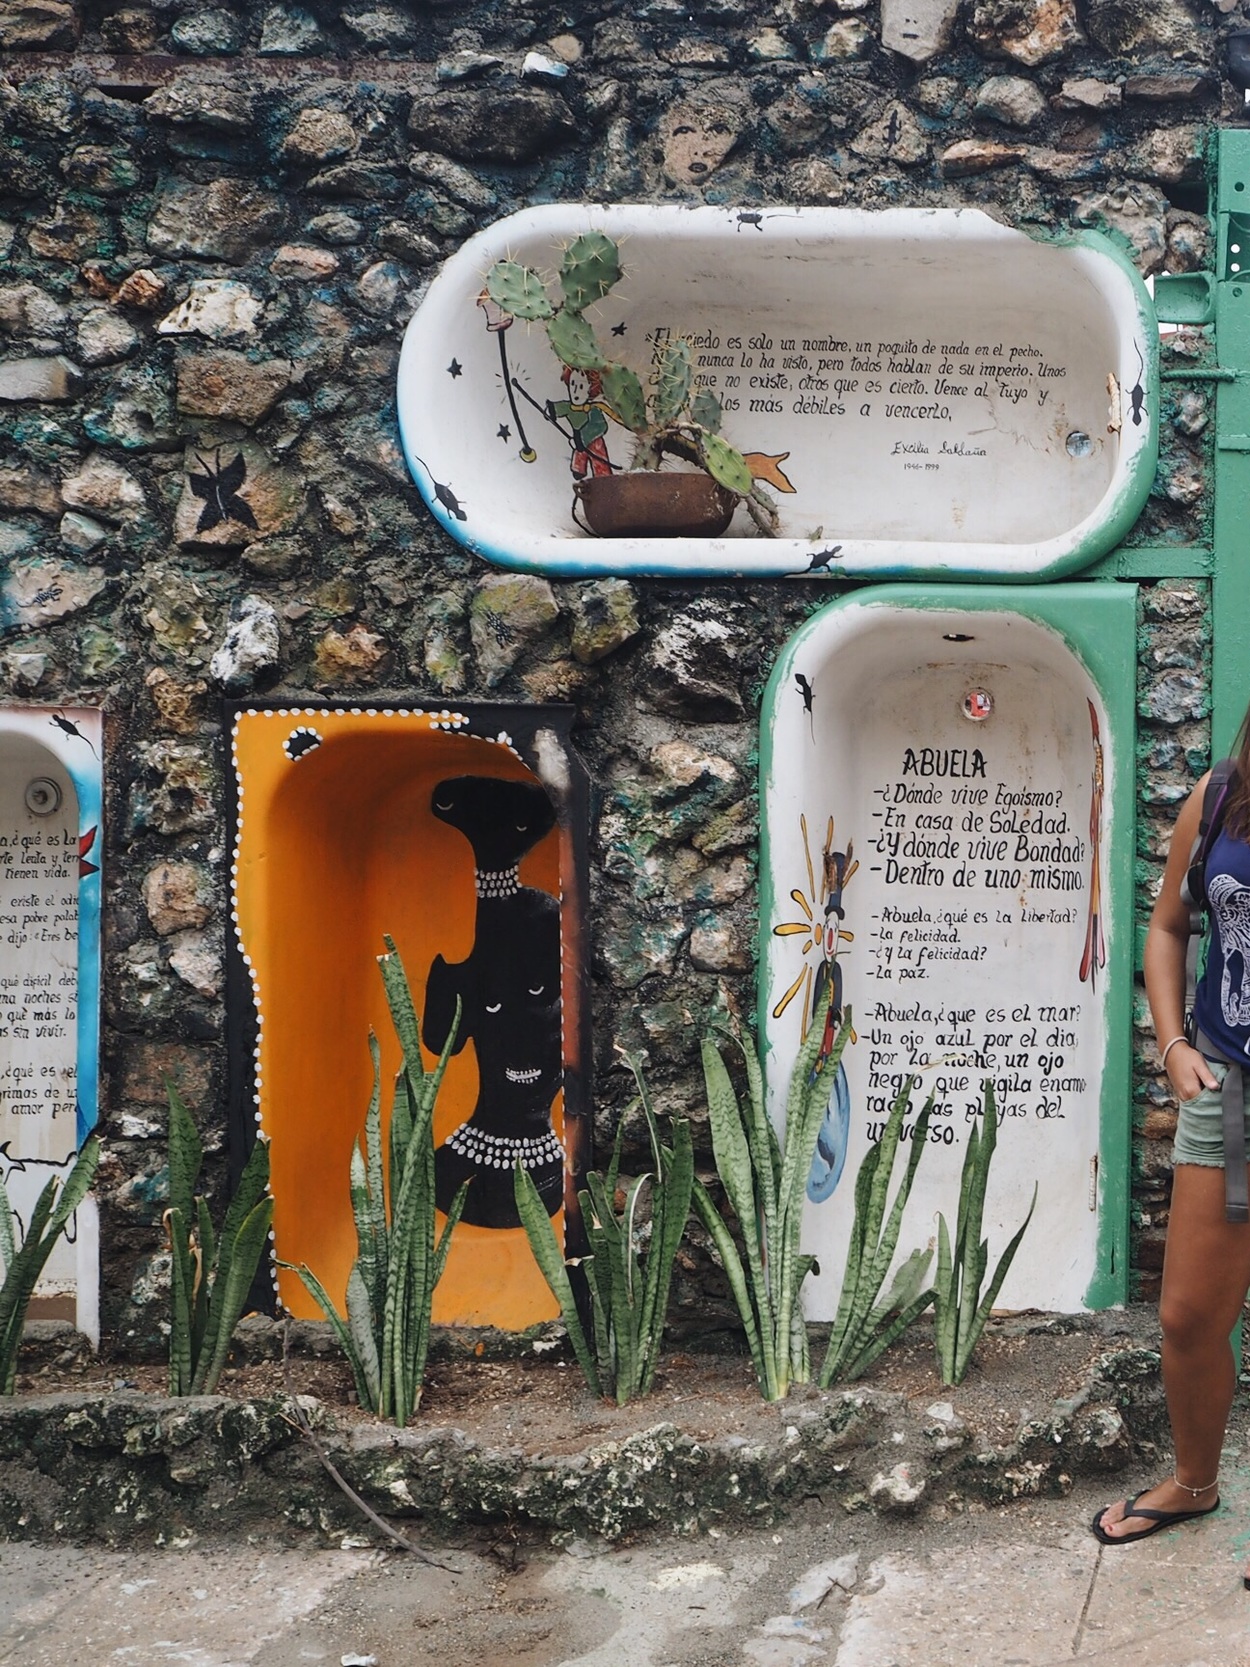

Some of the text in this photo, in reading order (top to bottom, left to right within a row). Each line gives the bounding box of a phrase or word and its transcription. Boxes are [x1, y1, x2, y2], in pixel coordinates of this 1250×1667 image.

[727, 335, 741, 349] es
[748, 333, 773, 350] solo
[780, 339, 796, 350] un
[855, 341, 871, 353] un
[877, 339, 918, 361] poquito
[922, 339, 937, 354] de
[941, 341, 969, 356] nada
[975, 345, 989, 356] en
[992, 343, 1004, 356] el
[1009, 344, 1043, 362] pecho.
[697, 353, 735, 368] nunca
[759, 353, 775, 369] ha
[782, 354, 813, 372] visto,
[816, 358, 844, 376] pero
[850, 356, 882, 372] todos
[886, 357, 931, 374] hablan
[938, 357, 954, 375] de
[959, 365, 974, 376] su
[979, 362, 1033, 382] imperio.
[1038, 362, 1067, 378] Unos
[693, 374, 717, 393] que
[724, 376, 741, 388] no
[798, 373, 829, 391] otros
[833, 379, 859, 400] que
[864, 381, 882, 393] es
[889, 379, 928, 395] cierto.
[974, 382, 989, 398] al
[999, 382, 1028, 404] tuyo
[1037, 389, 1050, 406] y
[859, 403, 871, 417] a
[902, 748, 988, 778] ABUELA
[951, 784, 989, 805] vive
[915, 814, 953, 831] casa
[961, 810, 983, 833] de
[46, 835, 60, 847] es
[902, 830, 960, 859] dónde
[967, 835, 1008, 861] vive
[1014, 834, 1085, 863] Bondad?
[51, 855, 59, 867] y
[44, 864, 70, 878] vida.
[952, 860, 977, 888] de
[985, 867, 1022, 889] uno
[1029, 864, 1085, 891] mismo.
[45, 894, 55, 906] el
[973, 912, 988, 924] es
[899, 926, 962, 944] felicidad.
[915, 945, 988, 967] felicidad?
[899, 967, 930, 985] paz.
[24, 989, 62, 1005] noches
[985, 1008, 1006, 1023] es
[1037, 1004, 1082, 1022] mar?
[13, 1024, 29, 1039] sin
[899, 1030, 924, 1052] ojo
[983, 1034, 1013, 1054] por
[40, 1065, 56, 1078] es
[869, 1050, 899, 1071] por
[1004, 1052, 1029, 1068] un
[1037, 1051, 1065, 1075] ojo
[44, 1082, 60, 1099] de
[935, 1075, 970, 1100] que
[11, 1102, 78, 1120] amor per
[964, 1096, 1027, 1128] plyas
